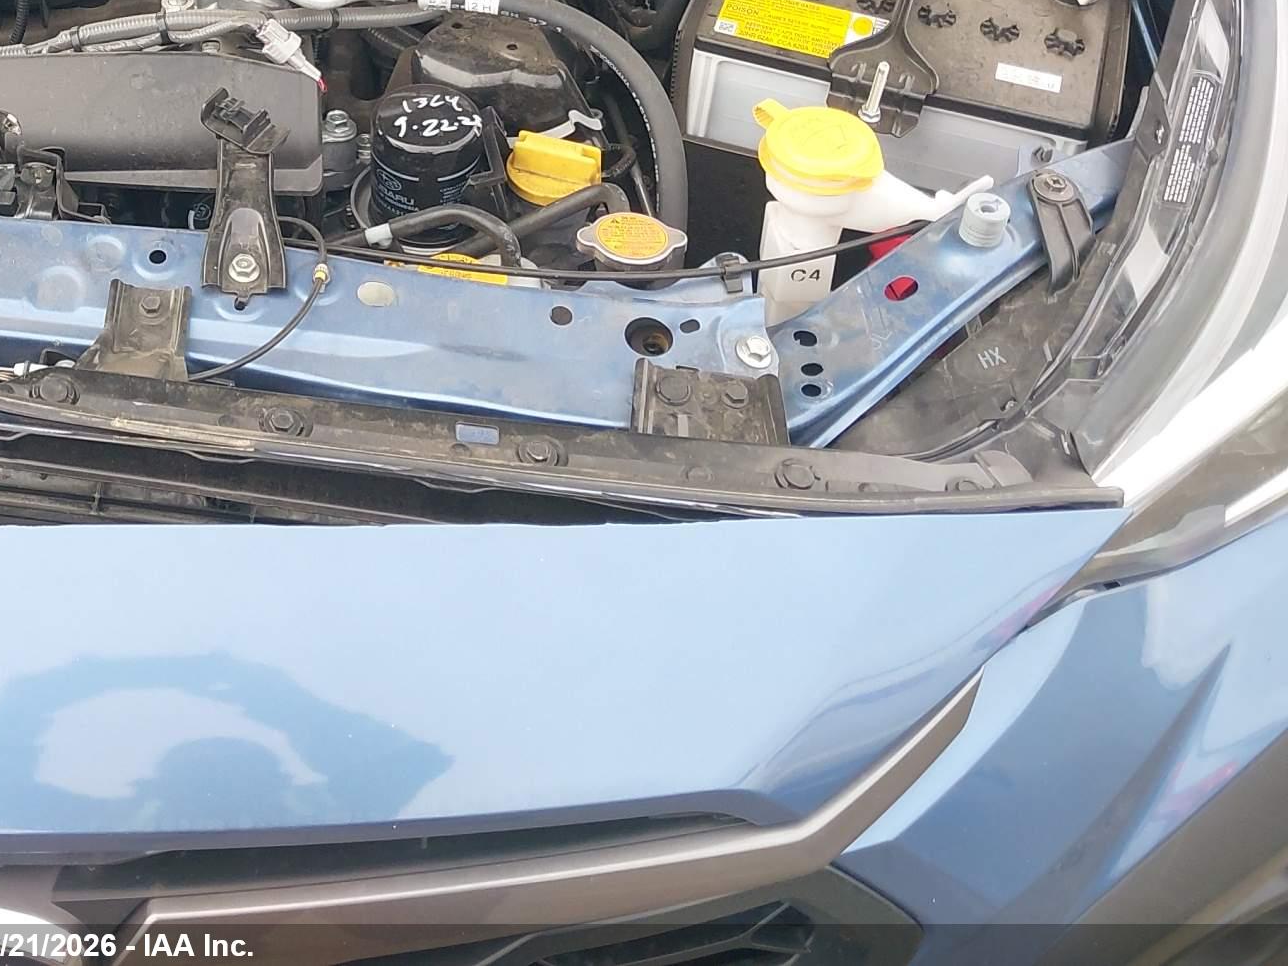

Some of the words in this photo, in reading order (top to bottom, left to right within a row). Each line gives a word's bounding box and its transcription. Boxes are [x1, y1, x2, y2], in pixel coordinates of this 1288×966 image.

[725, 3, 759, 16] POISON
[791, 269, 821, 282] C4
[977, 346, 1007, 369] HX
